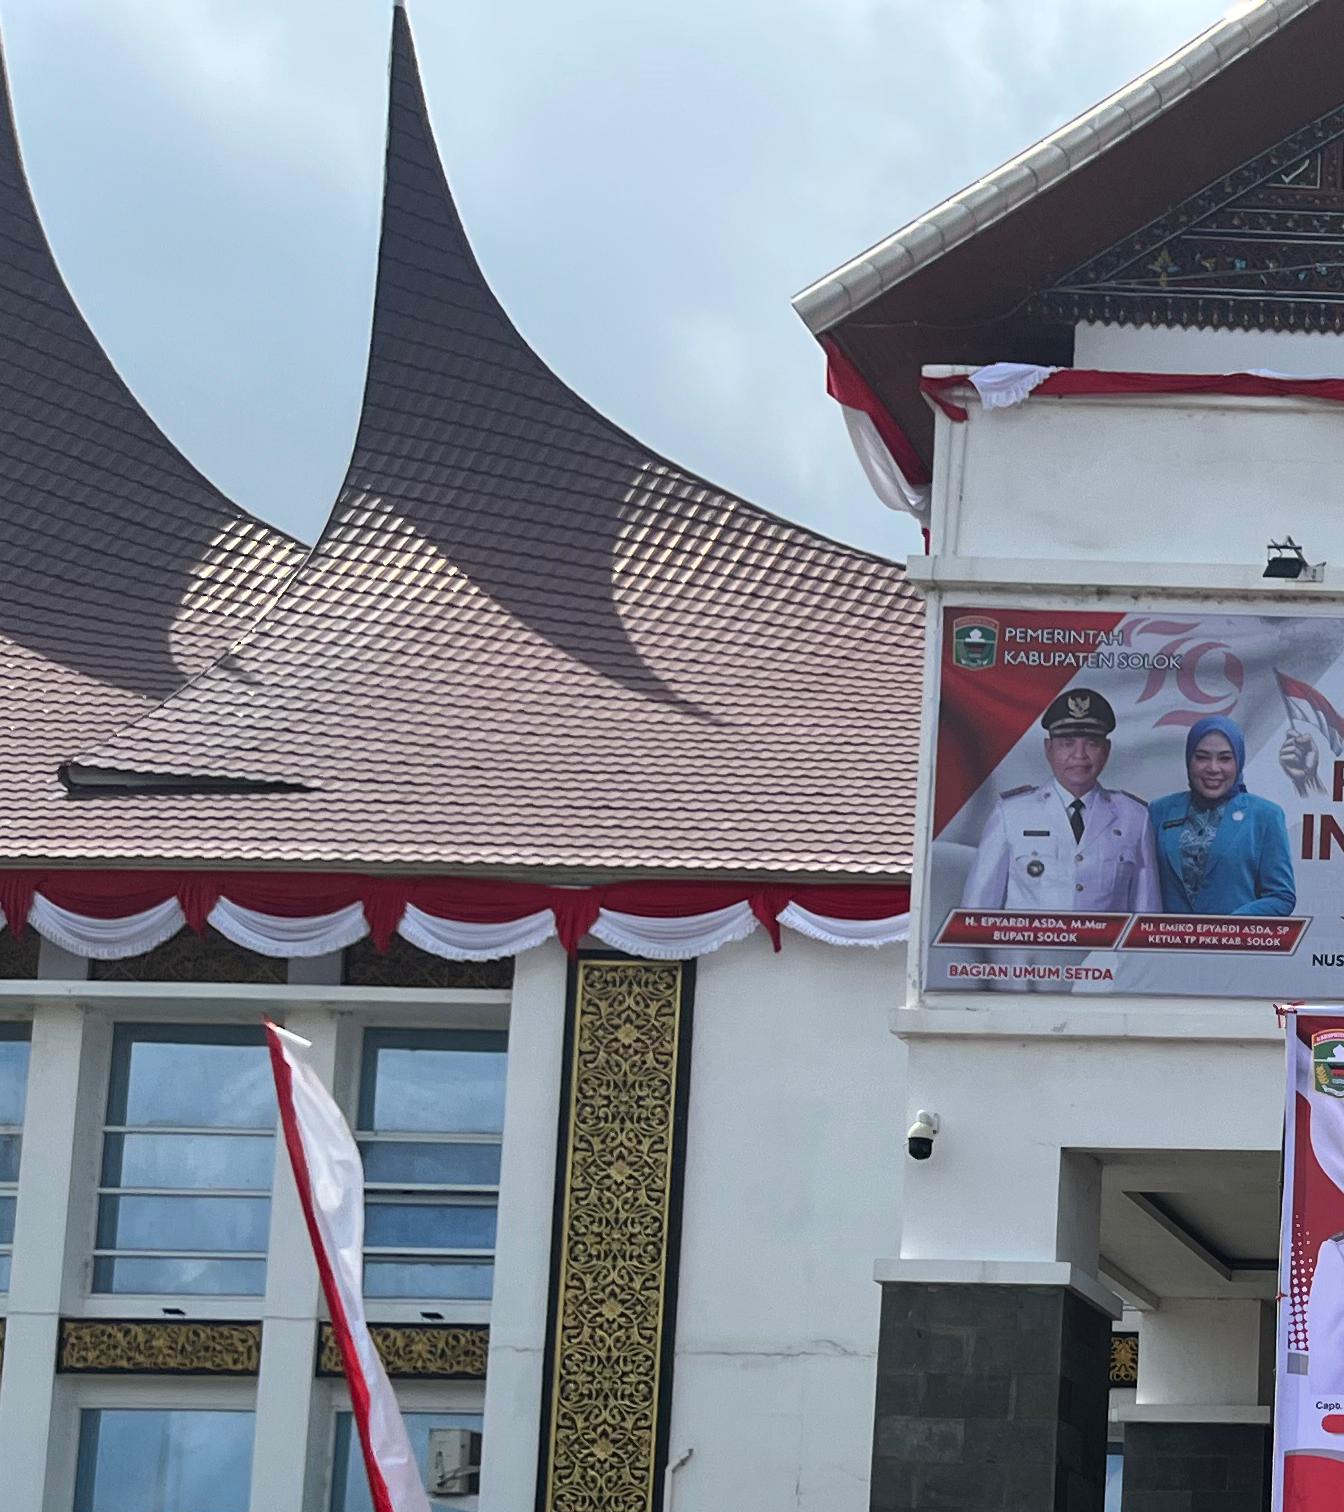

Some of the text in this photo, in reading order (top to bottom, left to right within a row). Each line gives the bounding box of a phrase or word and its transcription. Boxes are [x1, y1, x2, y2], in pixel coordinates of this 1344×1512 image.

[1004, 627, 1124, 646] PEMERINTAH
[1003, 650, 1183, 670] KABUPATEN SOLOK
[965, 916, 978, 927] H.
[980, 916, 1030, 928] EPYARDI
[1032, 918, 1068, 931] ASDA,
[1159, 923, 1194, 933] EMIKO
[1196, 923, 1240, 934] EPYARDI
[1242, 924, 1273, 936] ASDA,
[993, 930, 1078, 943] BUPATI SOLOK
[1148, 935, 1182, 945] KETUA
[1246, 937, 1281, 947] SOLOK
[949, 963, 1114, 981] BAGIAN UMUM SETDA
